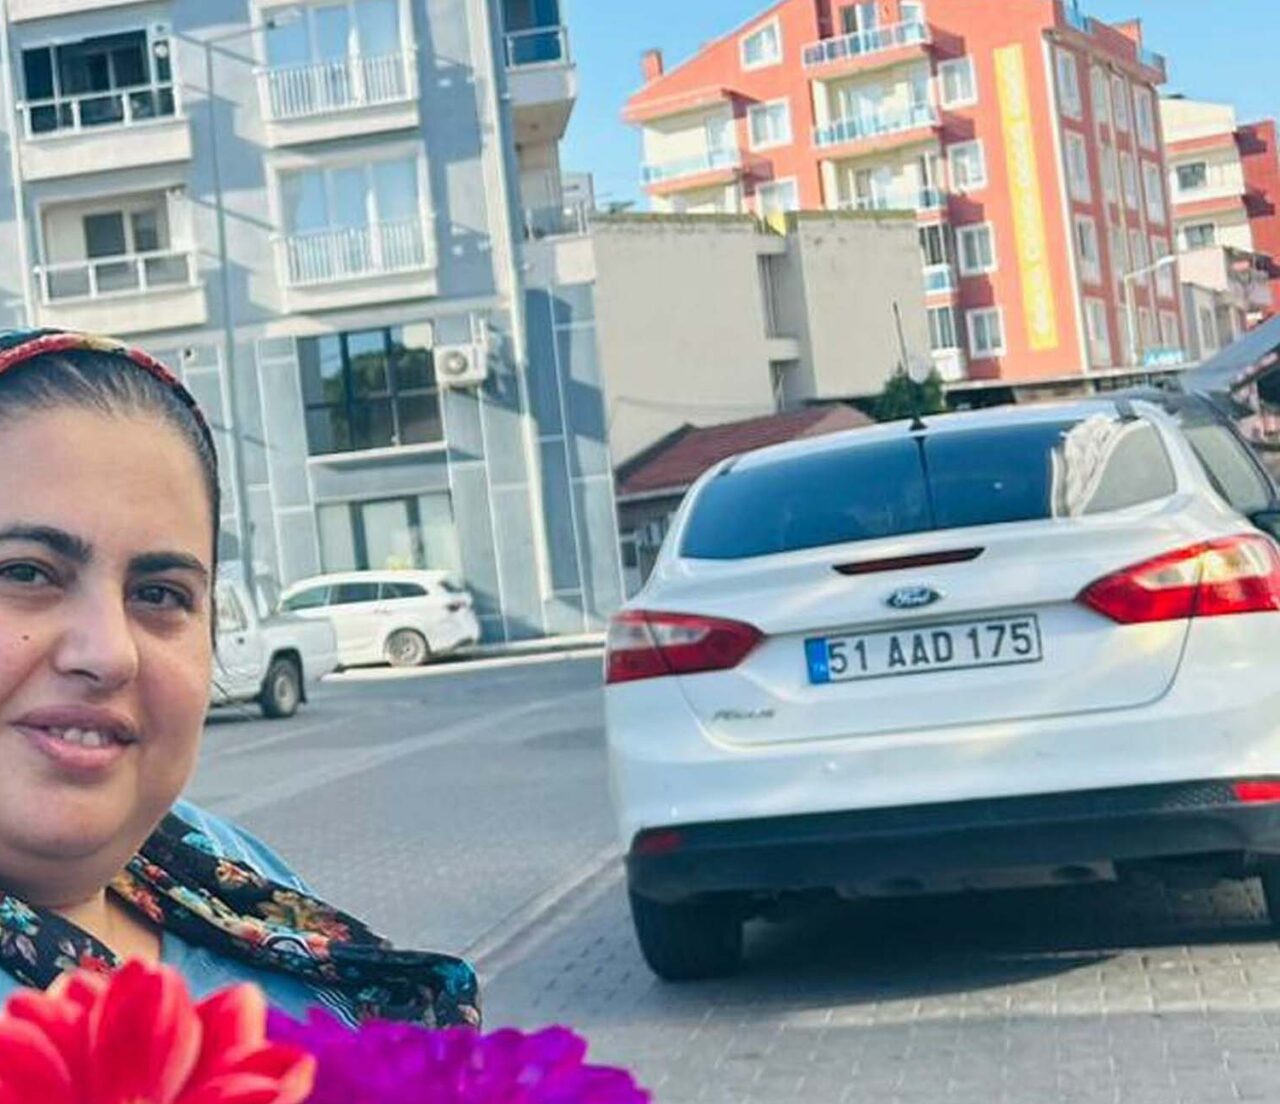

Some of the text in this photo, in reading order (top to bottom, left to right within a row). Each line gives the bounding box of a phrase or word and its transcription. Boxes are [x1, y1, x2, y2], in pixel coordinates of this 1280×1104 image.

[828, 621, 1032, 674] 51 AAD 175
